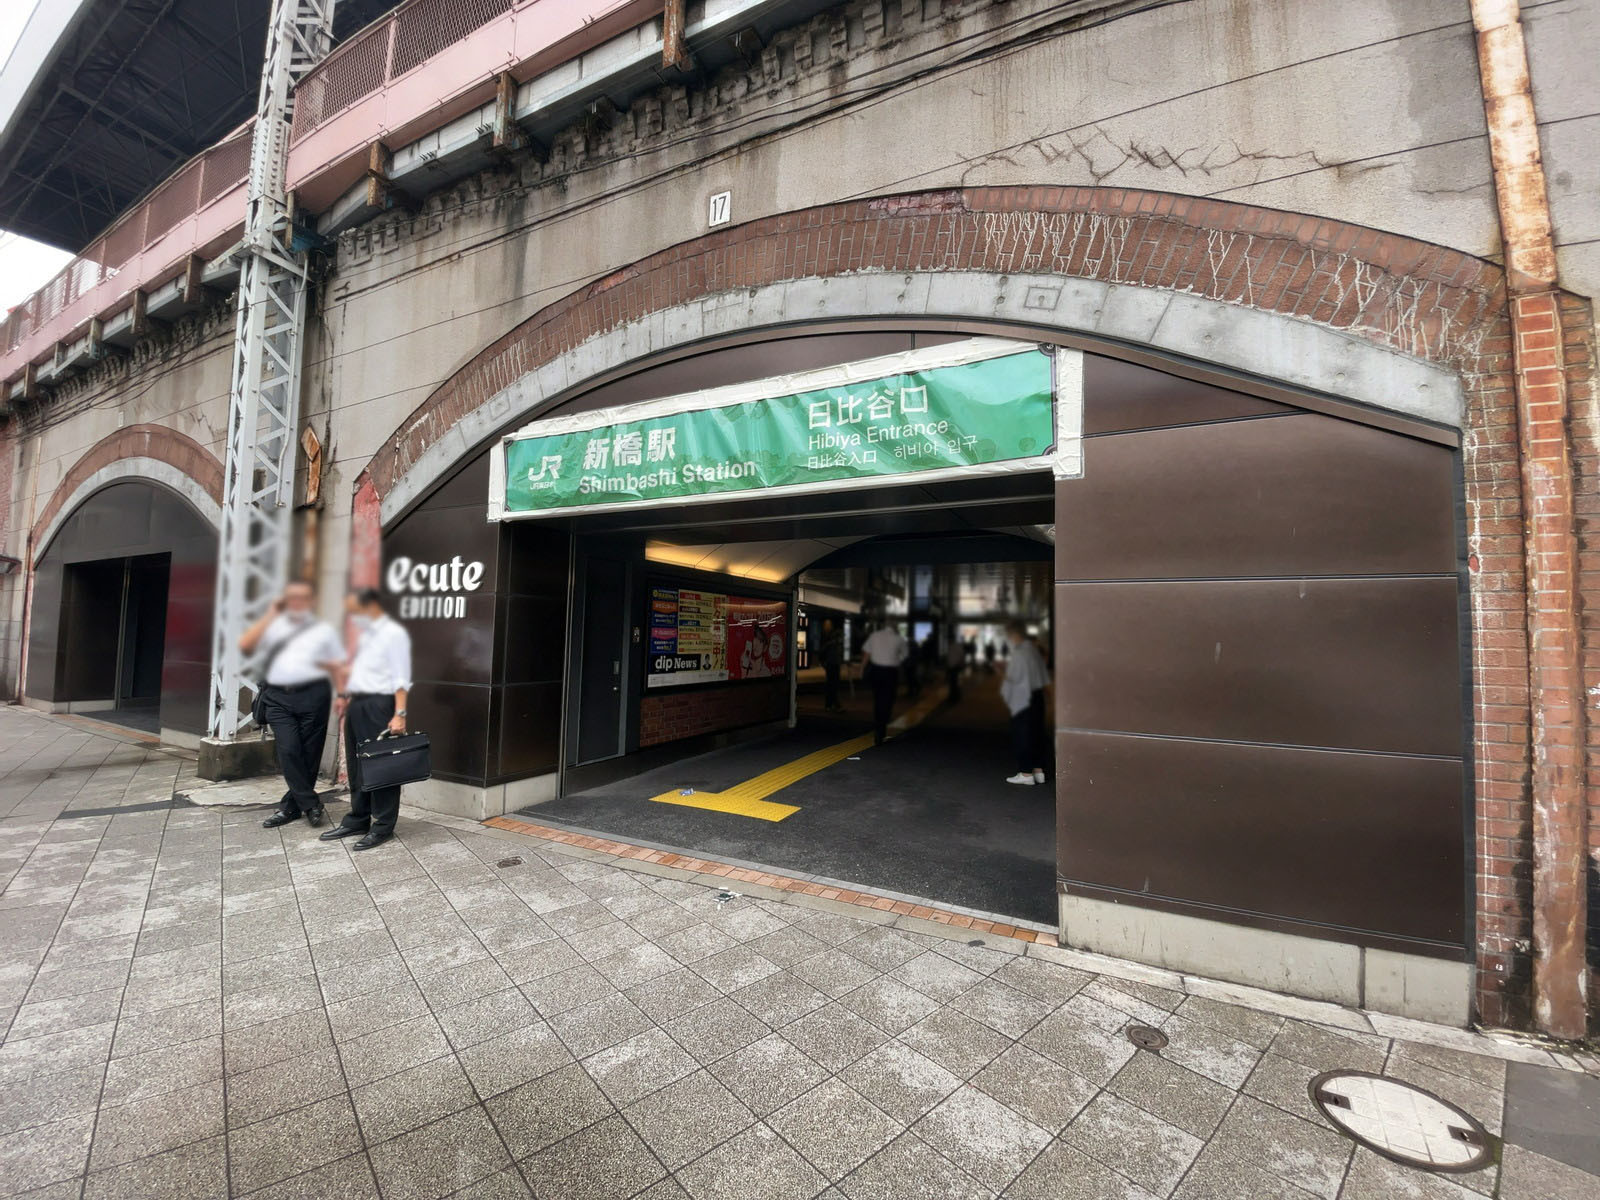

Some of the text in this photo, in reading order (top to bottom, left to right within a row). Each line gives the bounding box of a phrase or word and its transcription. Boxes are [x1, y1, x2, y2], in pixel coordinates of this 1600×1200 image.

[713, 195, 727, 222] 17
[808, 384, 928, 430] 日比谷口
[582, 427, 676, 470] 新橋駅
[808, 420, 949, 451] Hibiya Entrance
[947, 434, 978, 455] 입구
[528, 455, 562, 481] JR
[807, 450, 877, 471] 日比谷入口
[579, 460, 756, 494] Shimbashi Station
[387, 556, 484, 593] ecute
[655, 655, 697, 671] dip News
